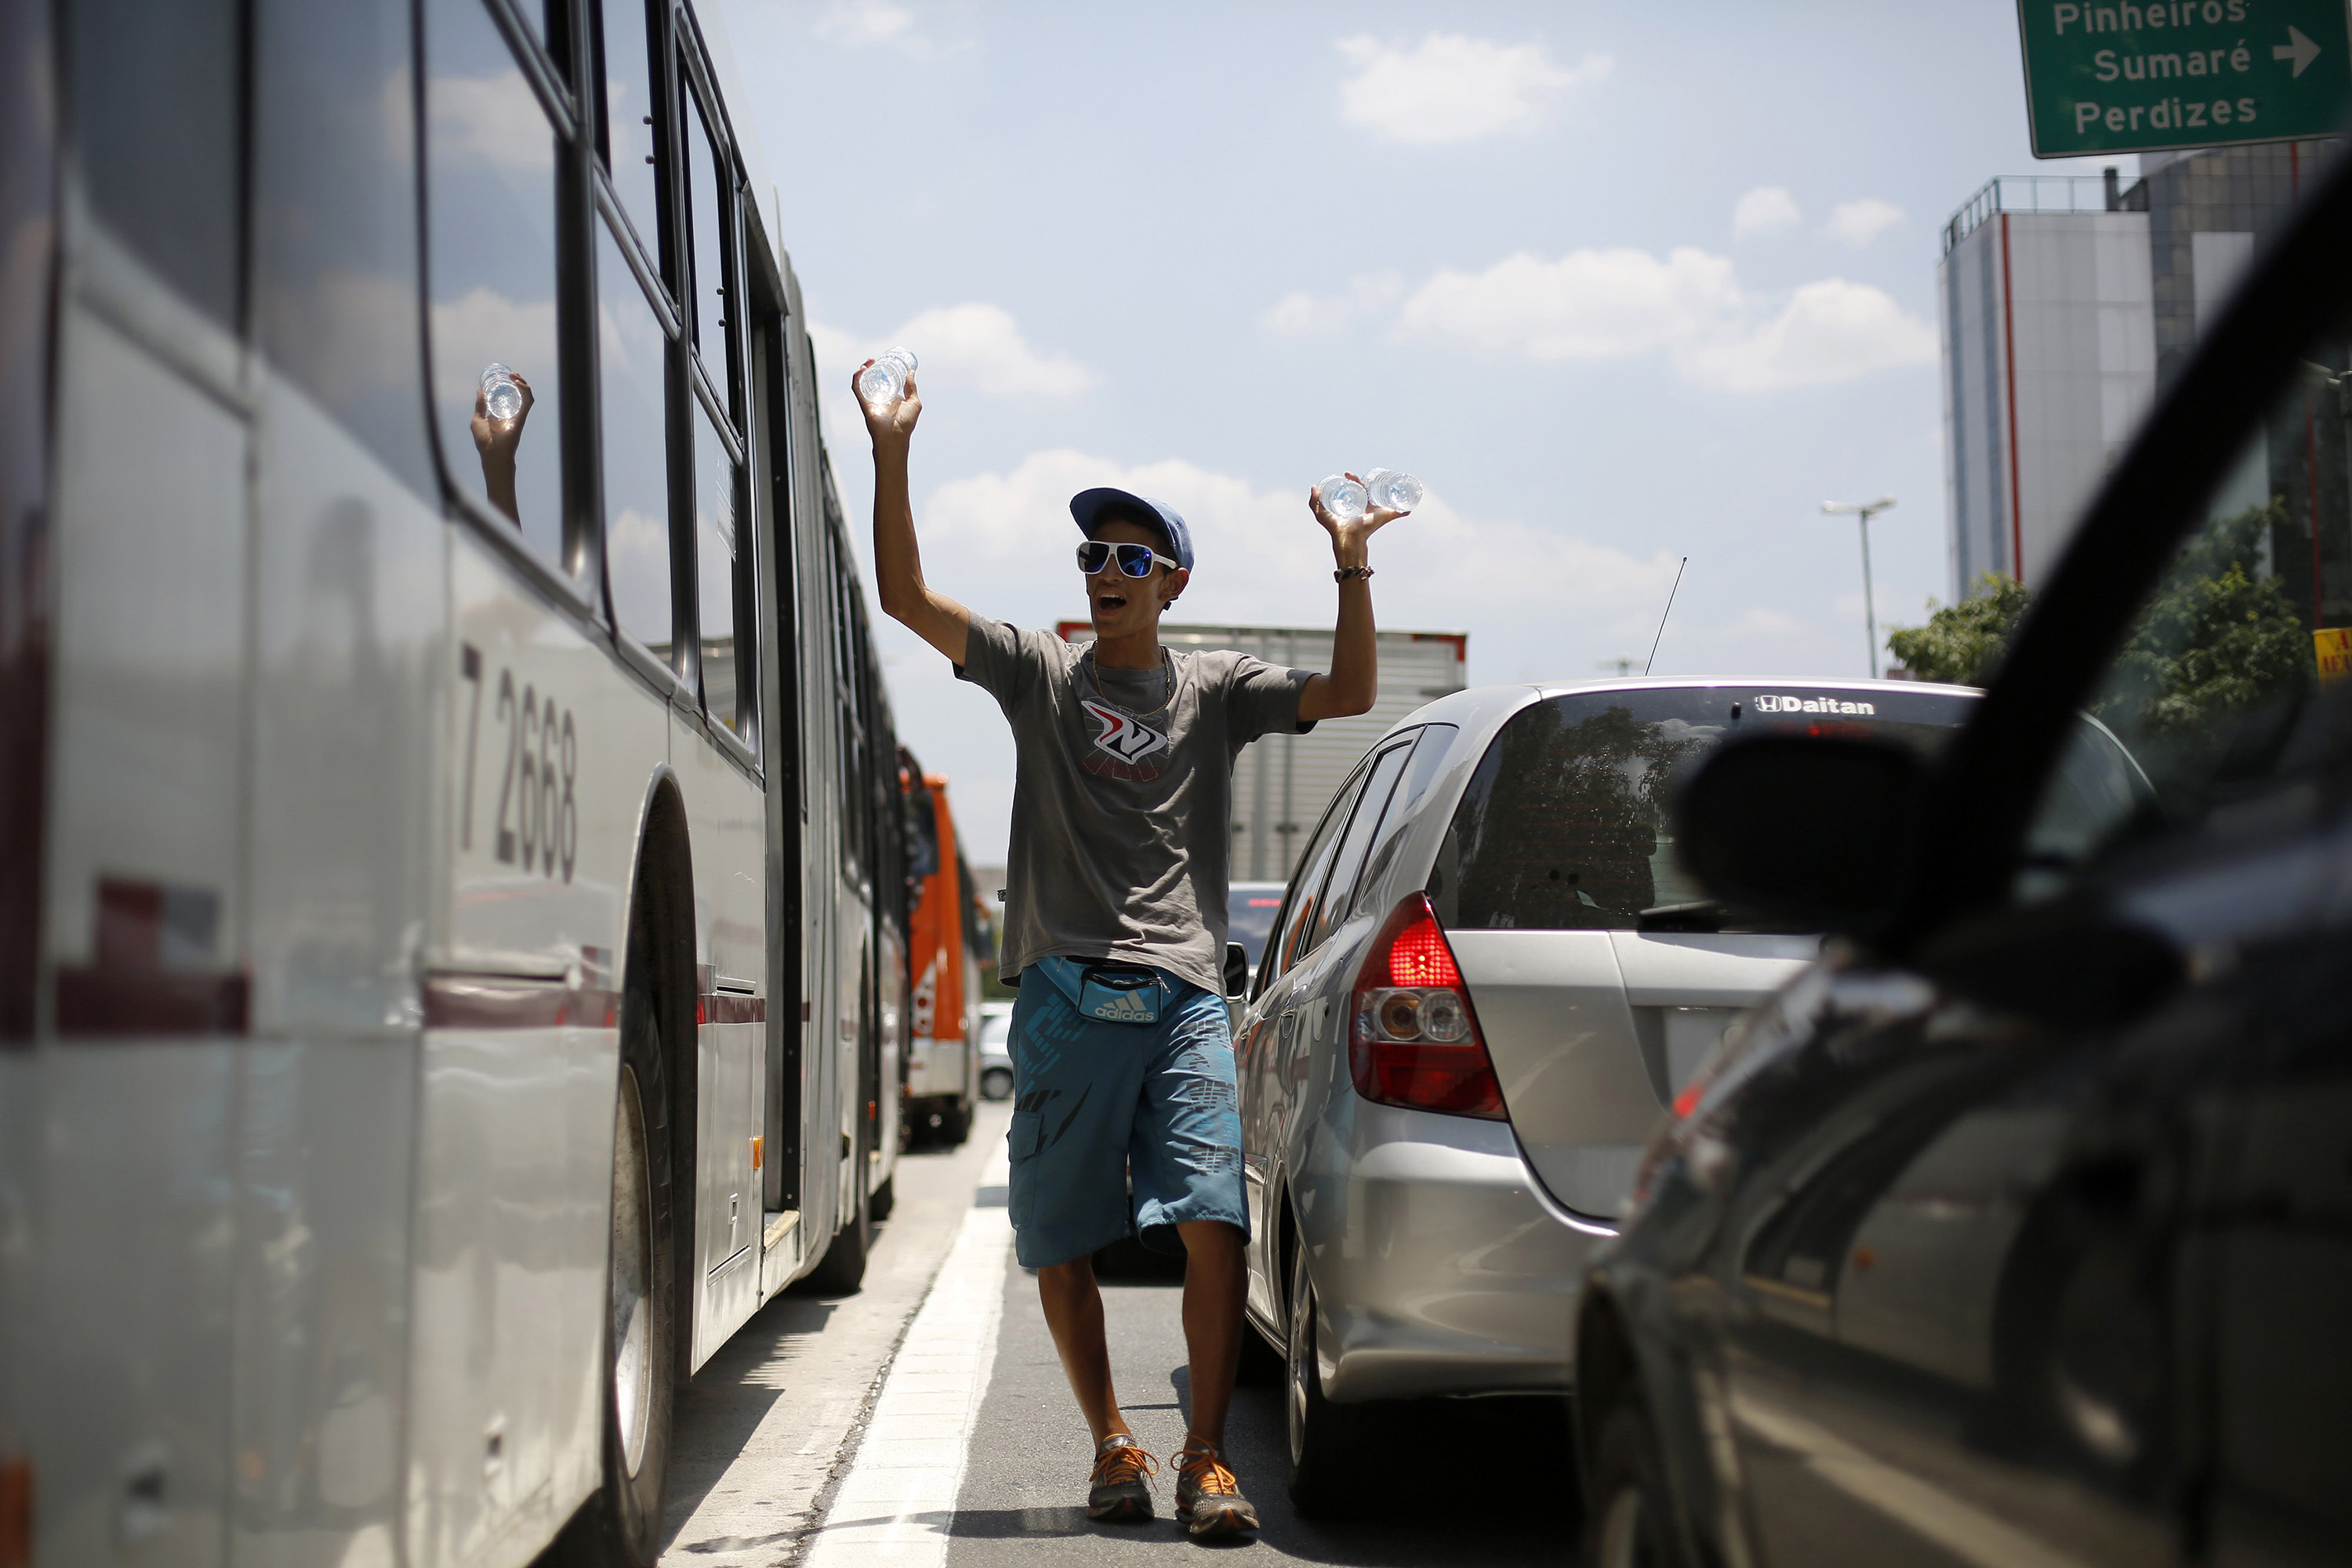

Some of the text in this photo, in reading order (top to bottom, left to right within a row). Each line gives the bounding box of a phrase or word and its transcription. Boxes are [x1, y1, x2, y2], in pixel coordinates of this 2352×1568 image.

[2054, 0, 2246, 35] Pinheiros
[2094, 38, 2251, 82] Sumaré
[2074, 96, 2257, 134] Perdizes
[1782, 696, 1875, 715] Daitan
[1094, 1007, 1155, 1022] adidas
